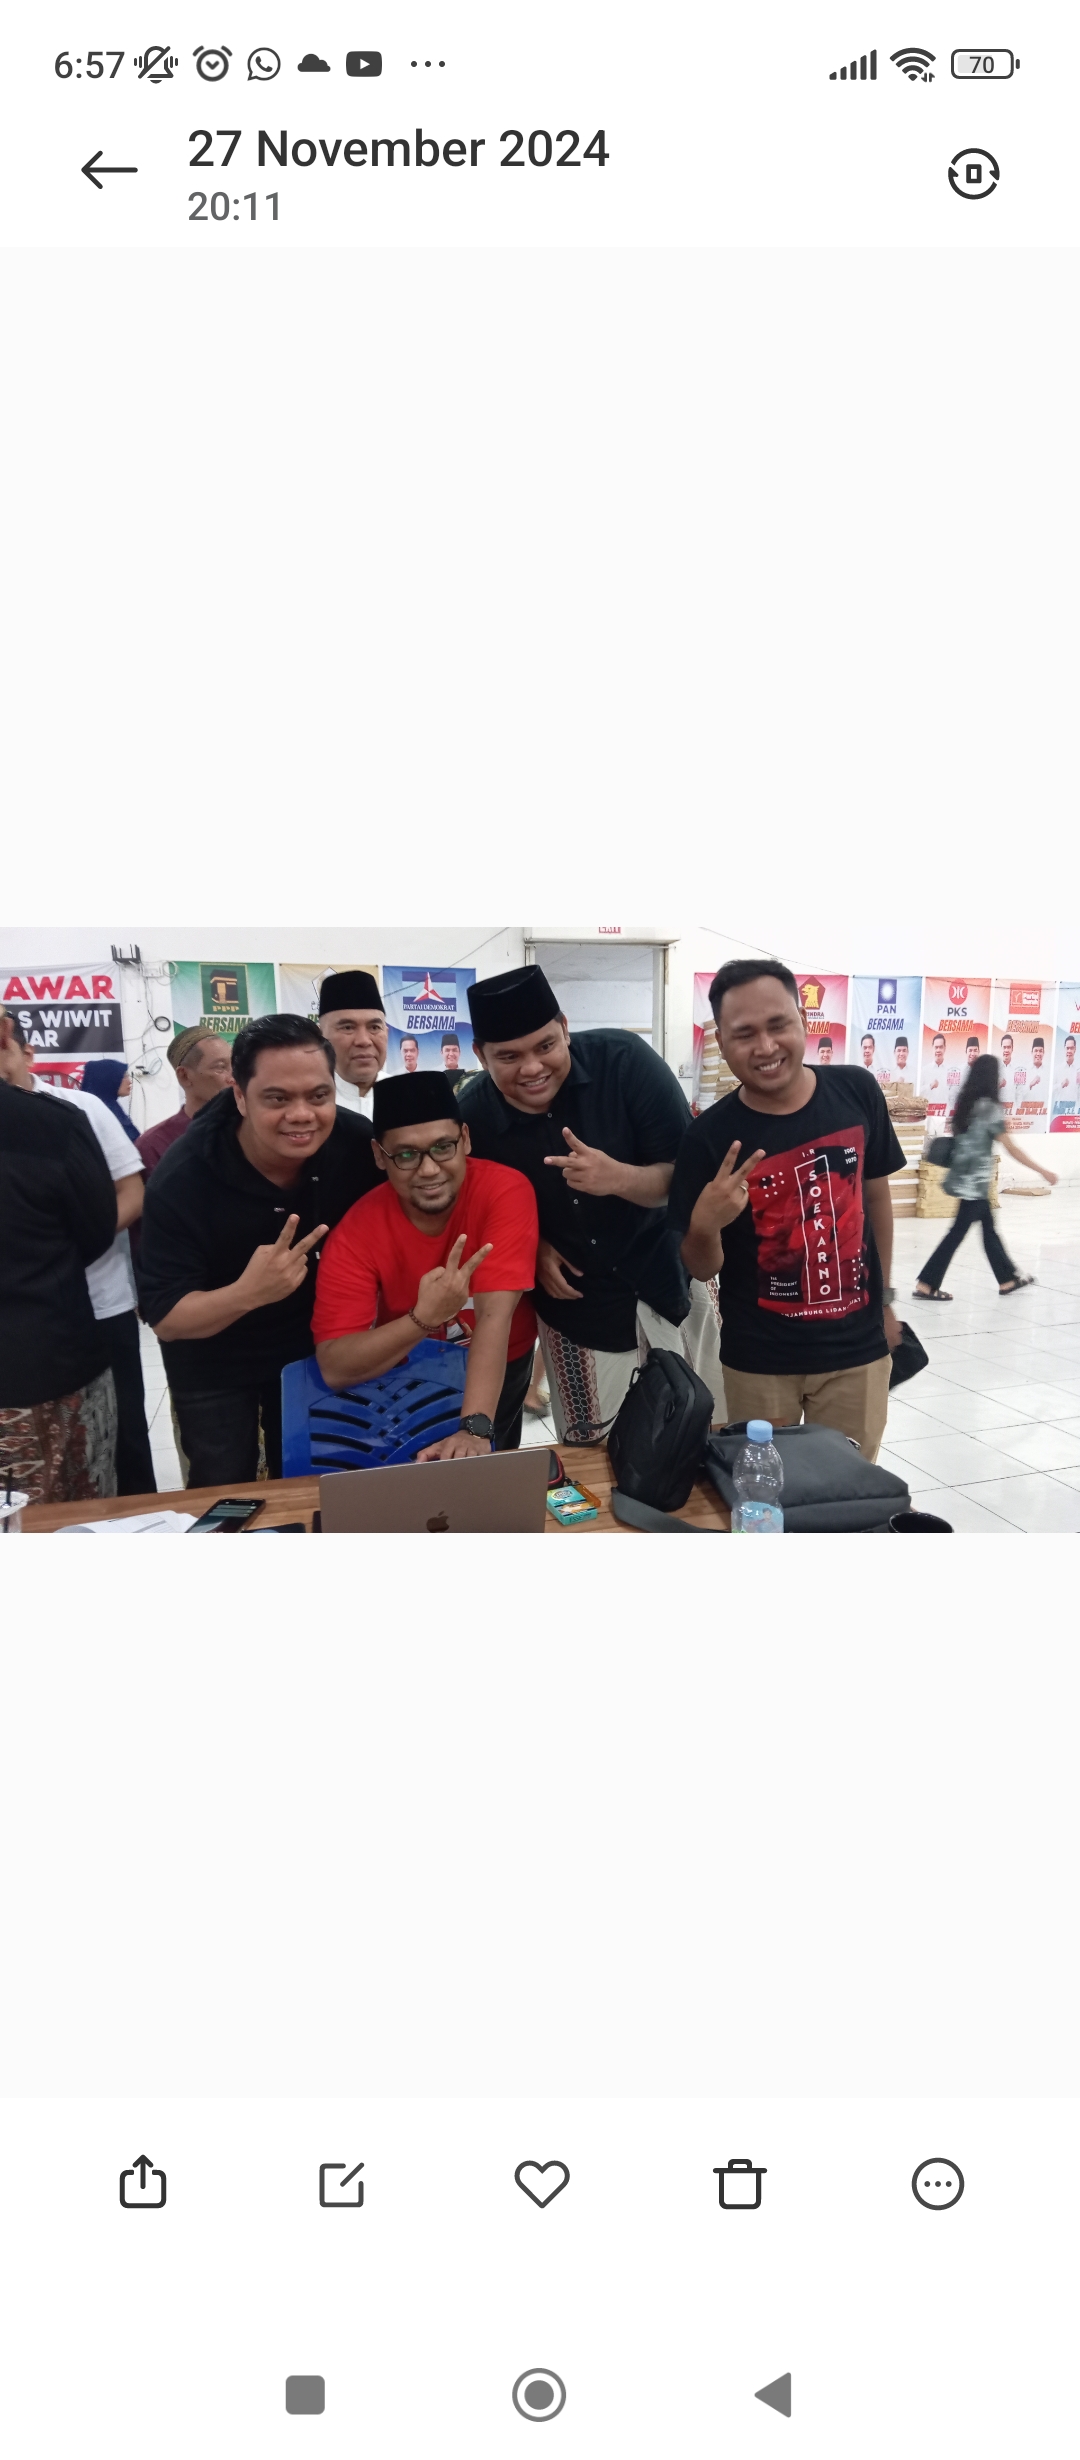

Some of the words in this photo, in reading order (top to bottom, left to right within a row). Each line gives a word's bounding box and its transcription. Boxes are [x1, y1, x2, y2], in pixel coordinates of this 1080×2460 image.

[876, 1005, 897, 1014] PAN
[947, 1007, 968, 1017] PKS
[39, 1009, 113, 1028] WIWIT
[406, 1015, 456, 1030] BERSAMA
[867, 1018, 905, 1031] BERSAMA
[806, 1021, 831, 1034] SAMA
[938, 1019, 975, 1032] BERSAMA
[808, 1169, 831, 1296] SOEKARNO
